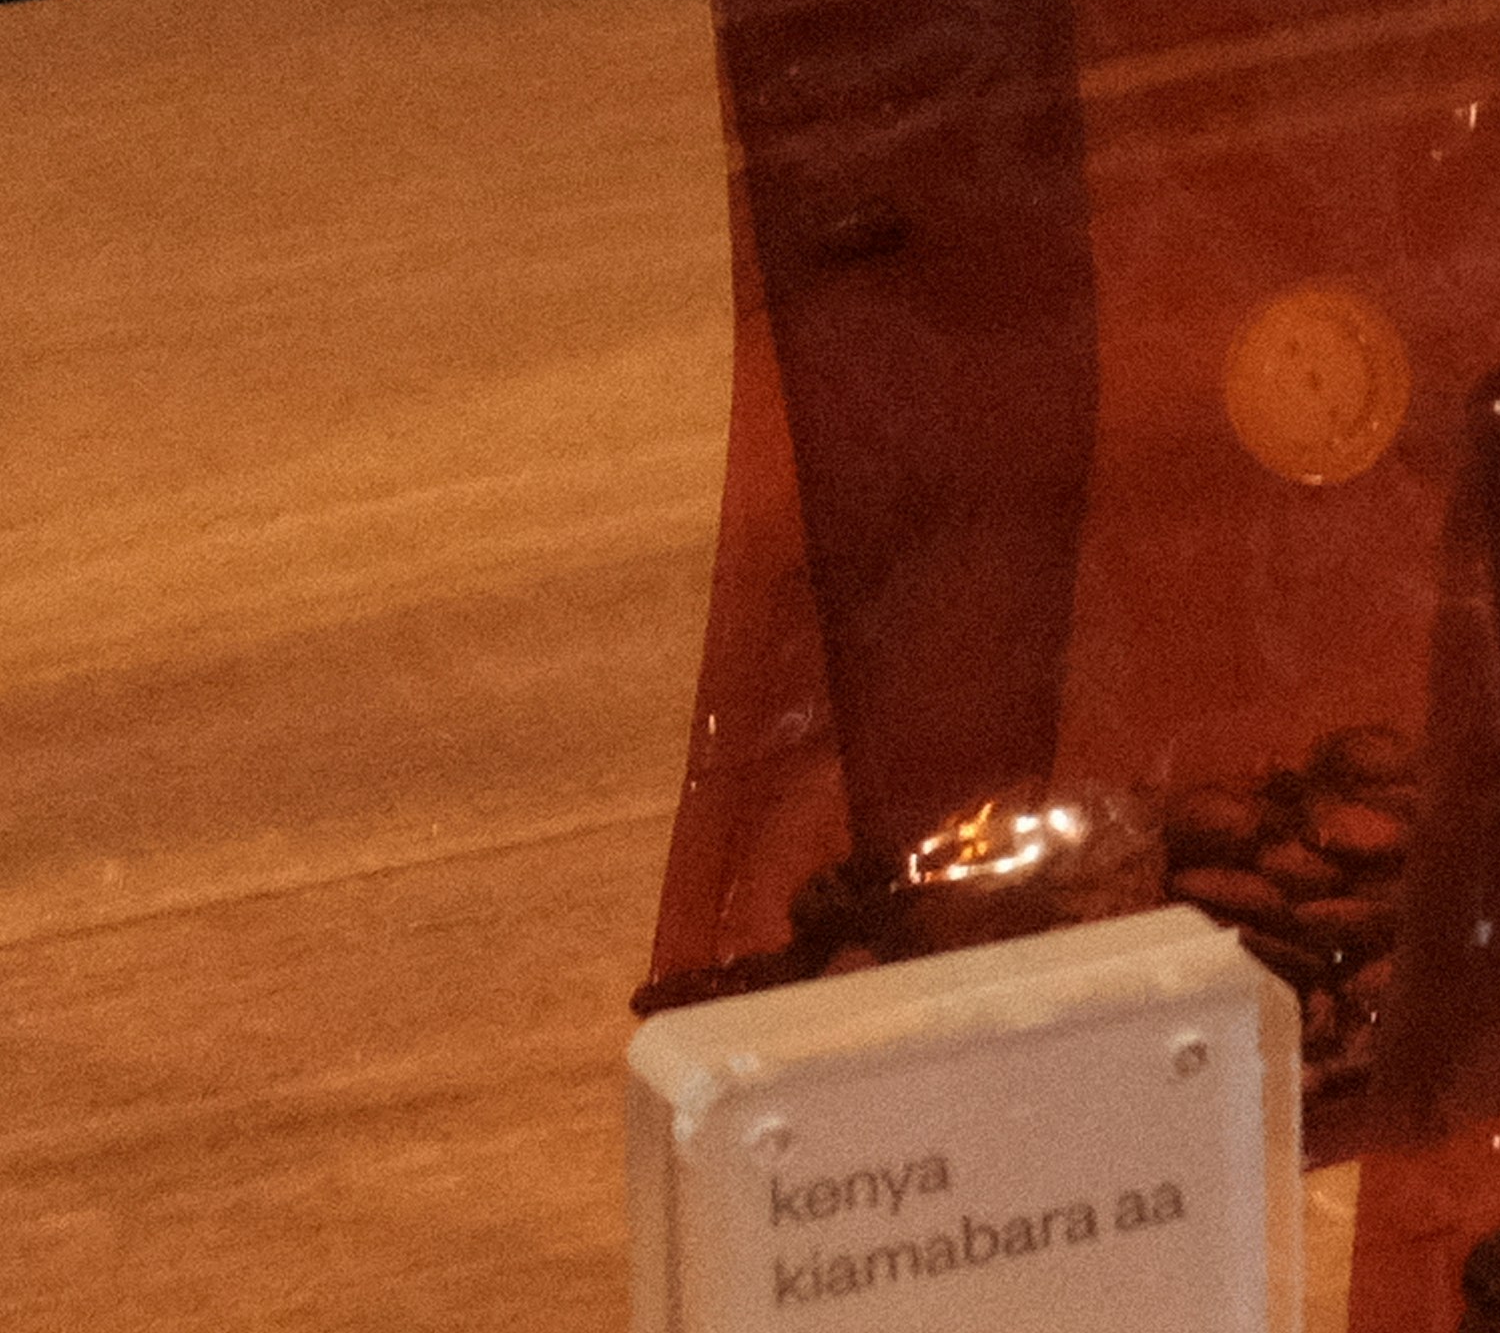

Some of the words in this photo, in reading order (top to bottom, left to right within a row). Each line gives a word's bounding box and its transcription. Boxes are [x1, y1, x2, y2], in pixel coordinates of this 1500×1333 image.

[769, 1152, 952, 1227] kenya
[772, 1202, 1100, 1308] kiamabara
[1113, 1179, 1187, 1233] aa
